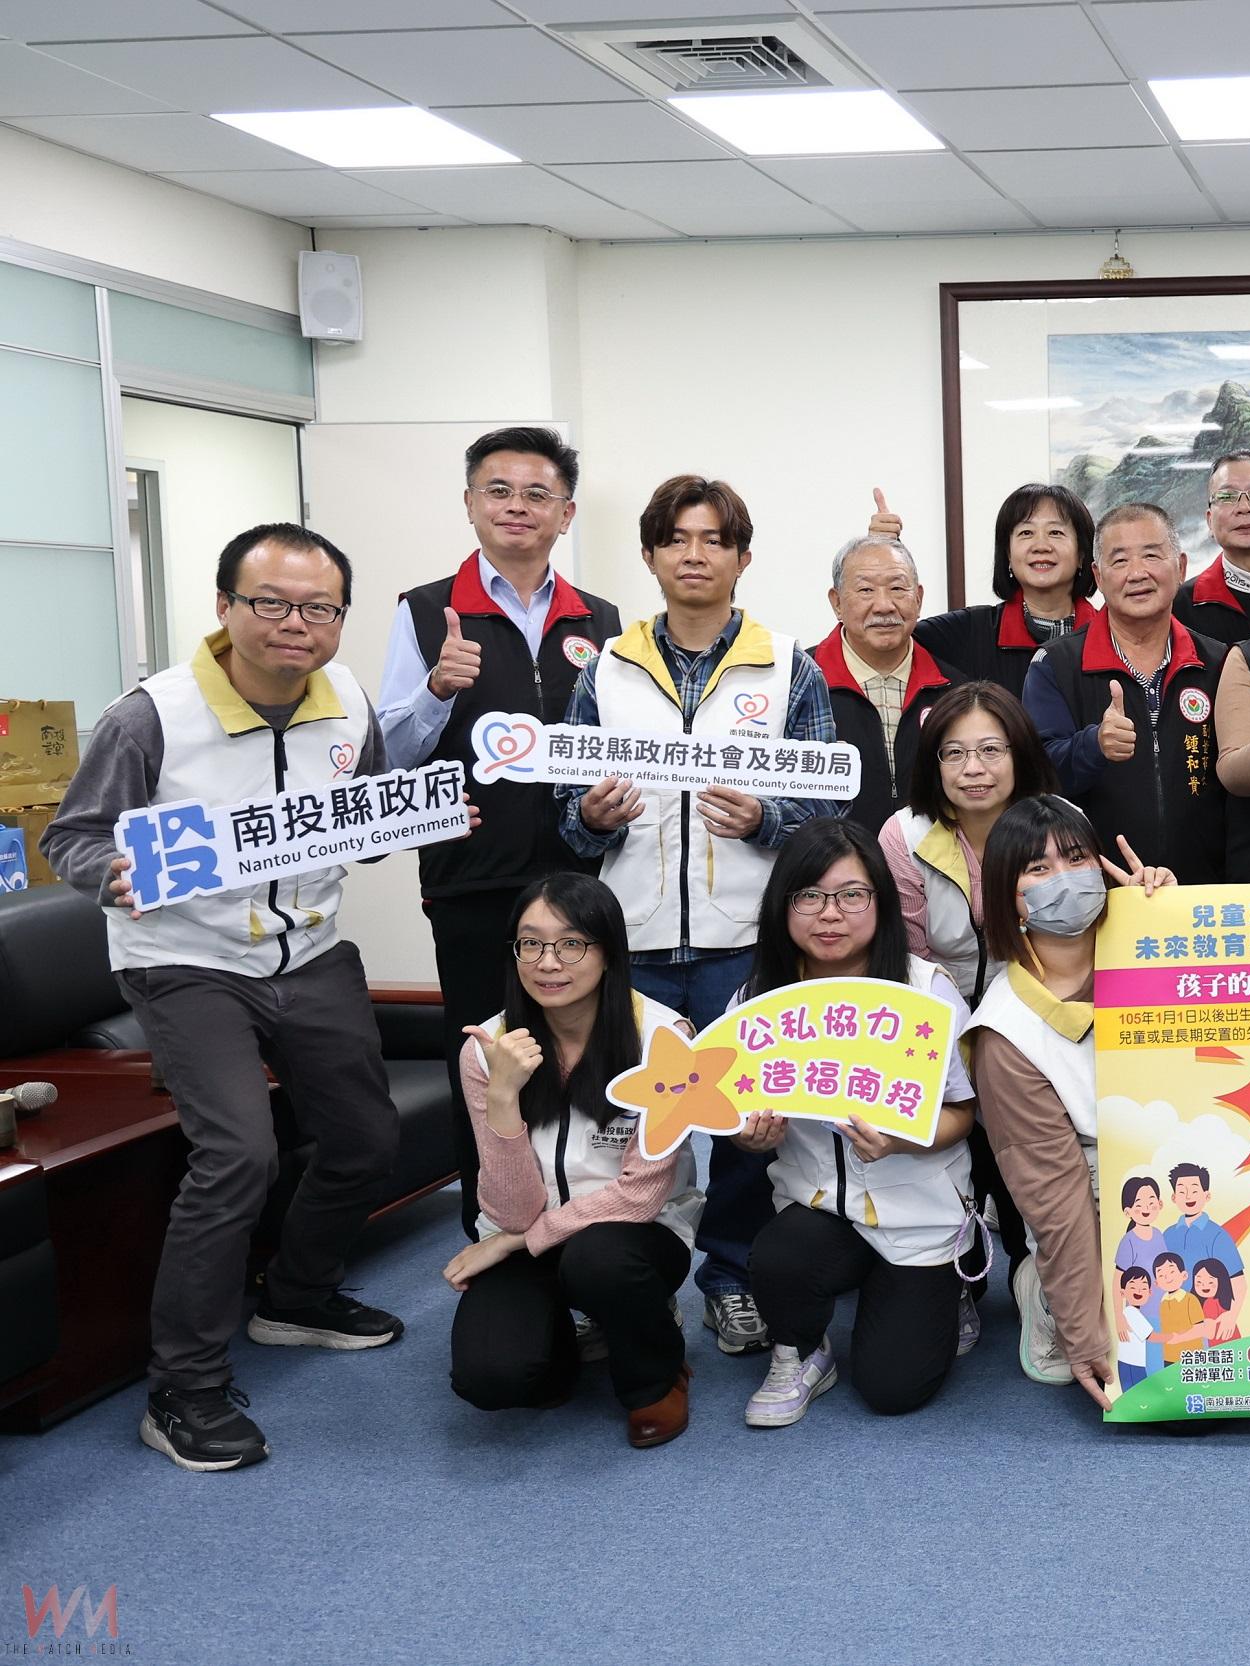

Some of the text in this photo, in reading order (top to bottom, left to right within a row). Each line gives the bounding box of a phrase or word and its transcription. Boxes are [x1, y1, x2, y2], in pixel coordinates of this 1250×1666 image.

[547, 732, 852, 777] 南投縣政府社會及勞動局
[548, 765, 579, 776] Social
[581, 768, 601, 778] and
[636, 771, 669, 782] Affairs
[671, 773, 711, 785] Bureau,
[713, 776, 750, 786] Nantou
[752, 778, 787, 791] County
[789, 780, 850, 793] Government
[230, 766, 461, 853] 南投縣政府
[238, 811, 466, 875] Nantou County Government
[739, 1003, 900, 1052] 公私協力
[762, 1060, 924, 1119] 造福南投
